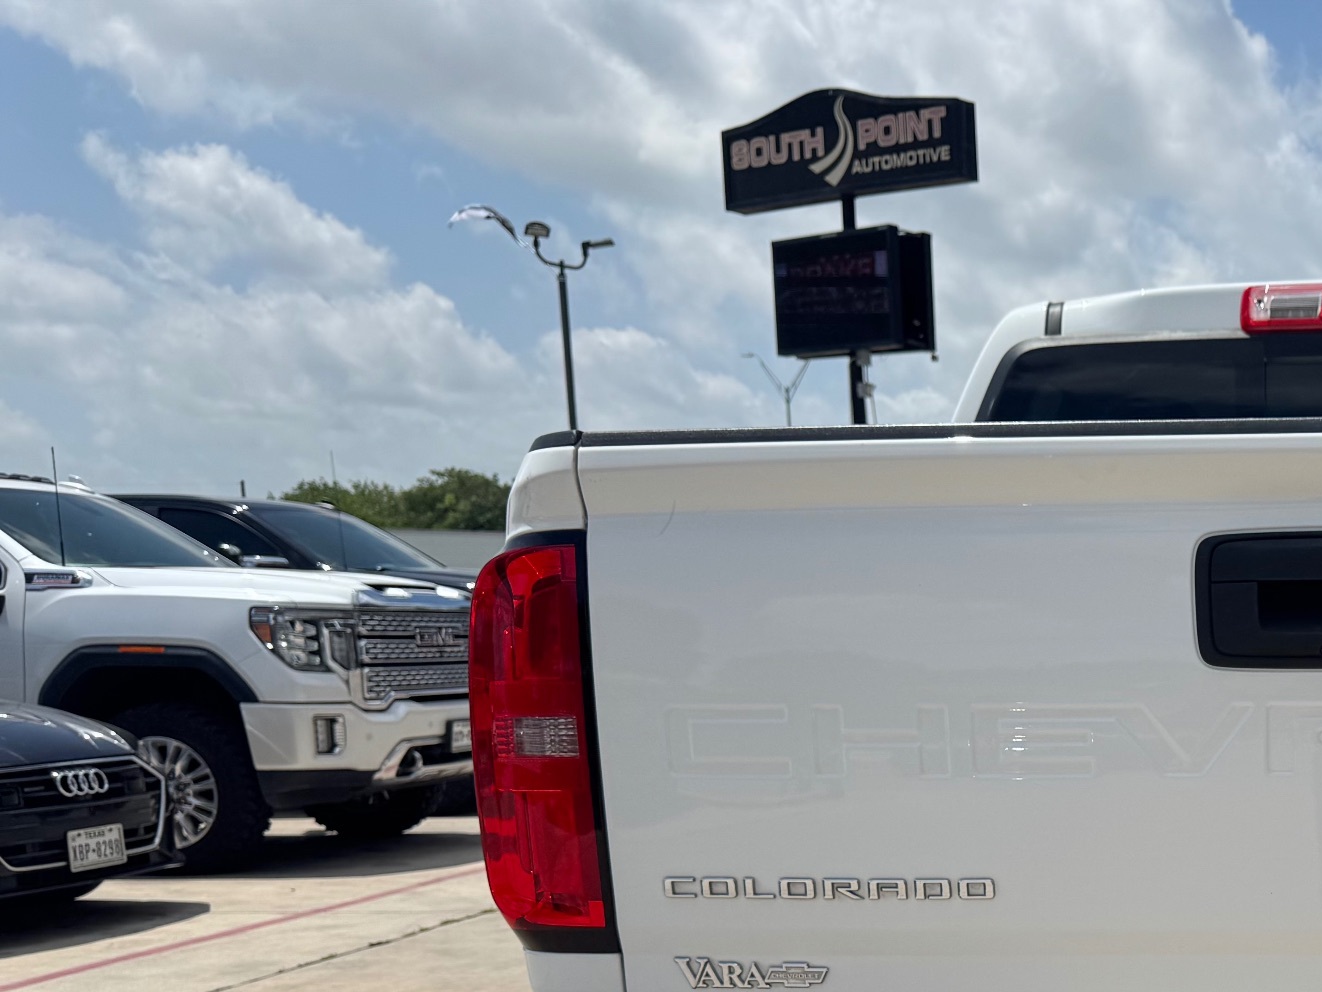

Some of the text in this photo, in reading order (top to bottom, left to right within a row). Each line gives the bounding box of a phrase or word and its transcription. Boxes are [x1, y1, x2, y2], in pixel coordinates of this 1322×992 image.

[730, 105, 947, 171] SOUTH POINT
[851, 145, 951, 175] AUTOMOTIVE
[663, 876, 996, 901] COLORADO
[673, 956, 771, 989] VARA
[771, 971, 820, 980] CHEVROLET
